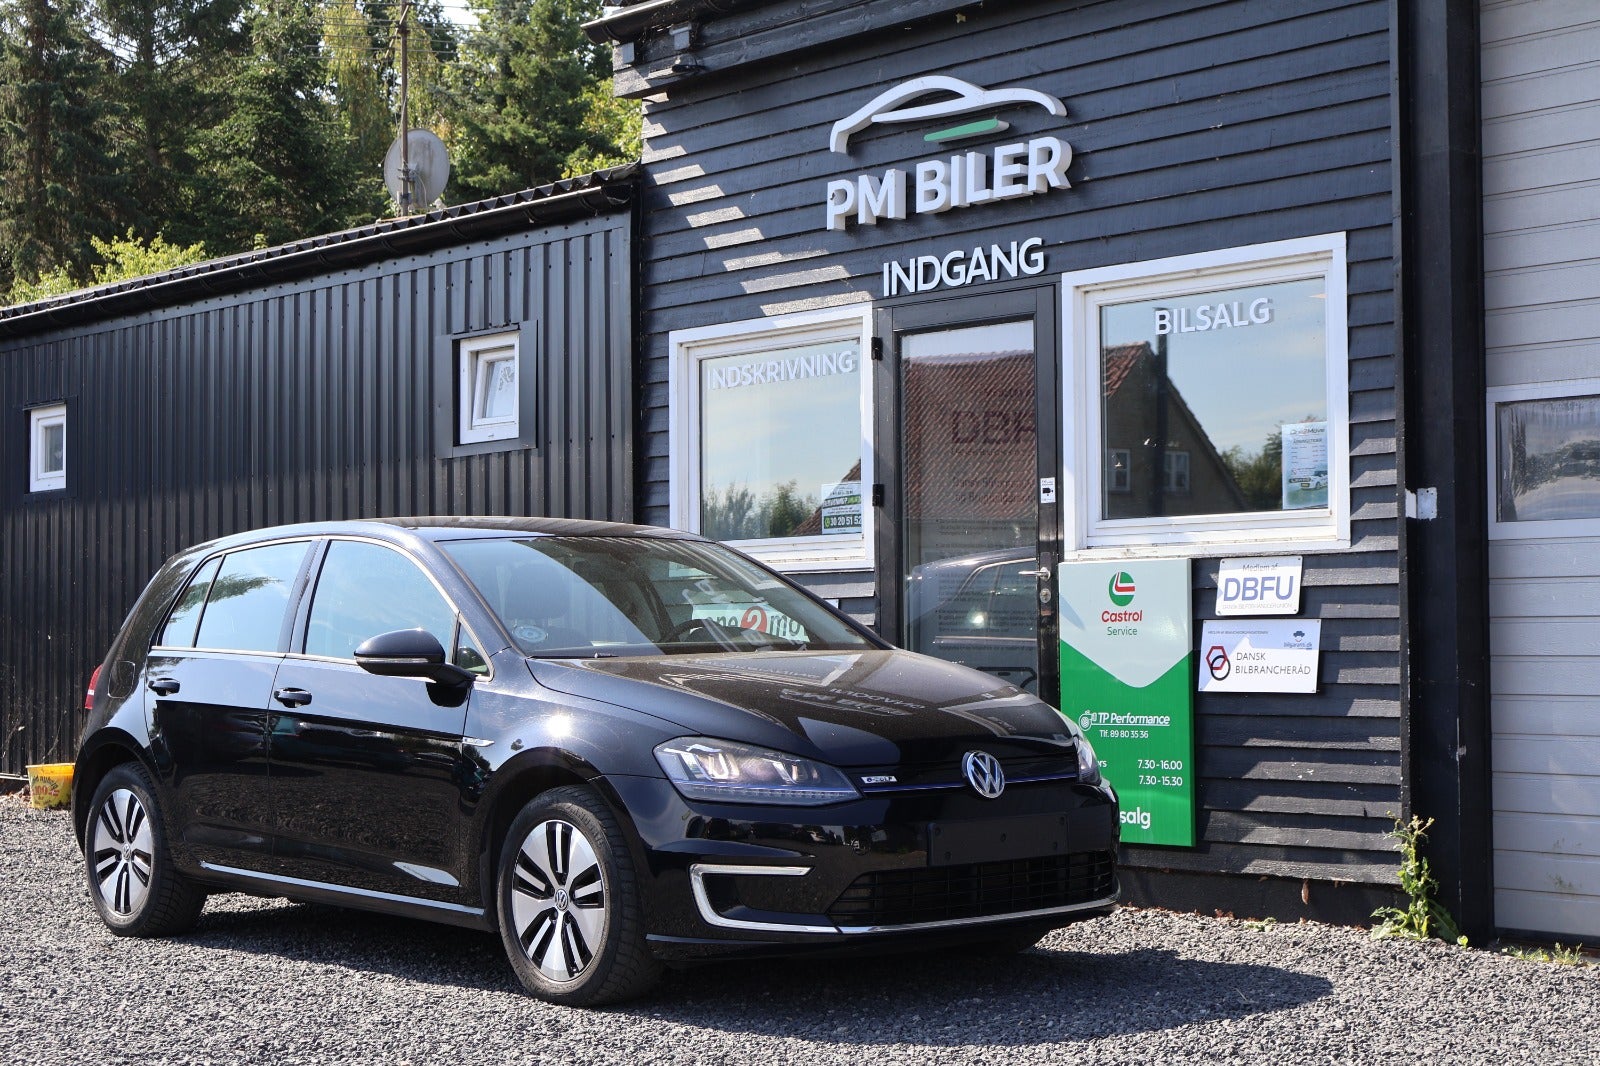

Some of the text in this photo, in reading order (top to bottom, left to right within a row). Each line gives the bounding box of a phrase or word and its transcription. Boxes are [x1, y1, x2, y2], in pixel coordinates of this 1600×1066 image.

[827, 136, 1073, 230] PM BILER
[883, 237, 1045, 297] INDGANG
[1155, 297, 1271, 335] BILSALG
[706, 350, 855, 391] INDSKRIVNING
[1242, 563, 1270, 572] Medlem
[1223, 575, 1294, 602] DBFU
[1101, 609, 1143, 623] Castrol
[1107, 626, 1138, 636] Service
[1236, 652, 1266, 661] DANSK
[1235, 664, 1311, 675] BILBRANCHERÅD
[1098, 712, 1171, 725] TP Performance
[1100, 729, 1149, 739] Tlf. 89 80 35 36
[1097, 760, 1108, 768] rs
[1119, 806, 1151, 830] salg
